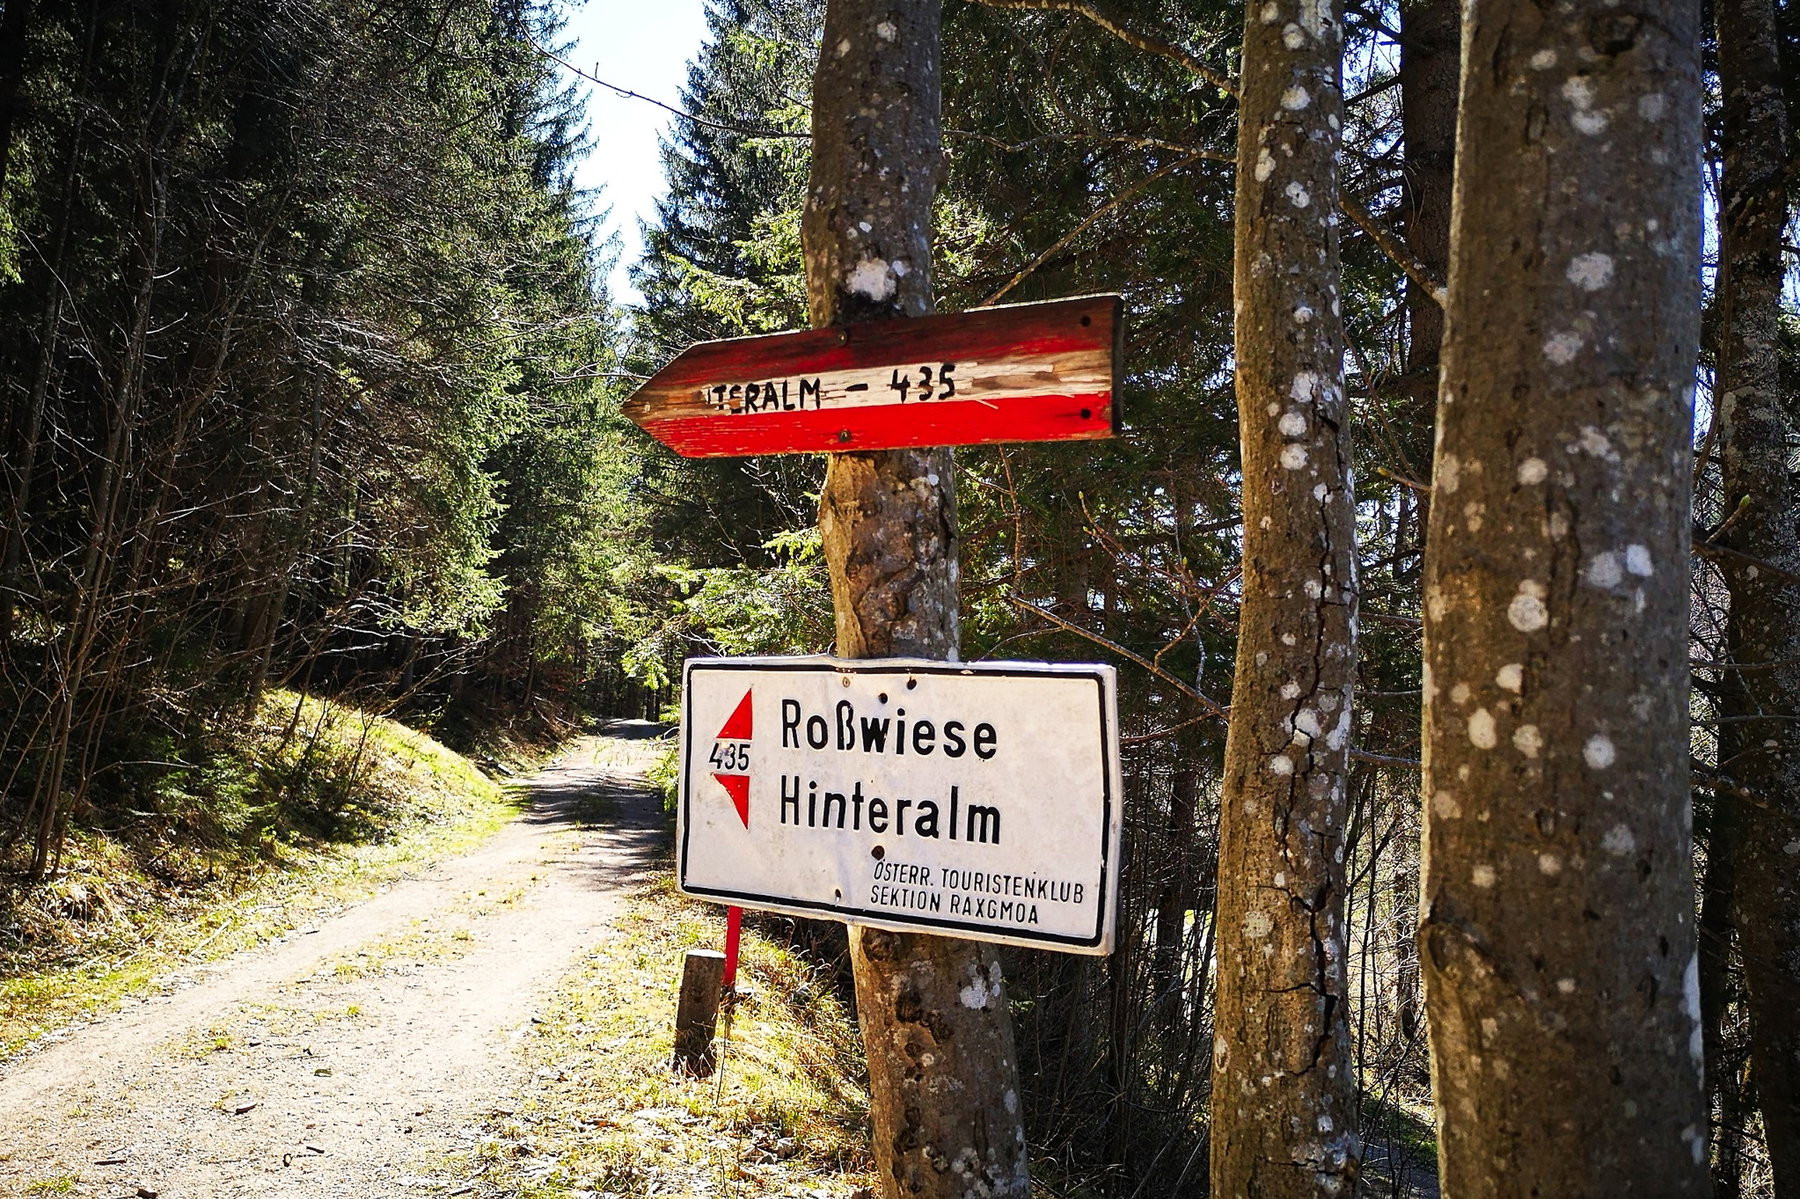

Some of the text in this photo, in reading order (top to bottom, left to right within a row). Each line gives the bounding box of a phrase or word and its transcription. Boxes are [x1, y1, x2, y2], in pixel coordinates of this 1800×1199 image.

[887, 364, 956, 403] 435
[781, 698, 998, 760] Roßwiese
[708, 742, 750, 771] 435
[780, 774, 1001, 845] Hinteralm
[870, 885, 1039, 924] SEKTION RAXGMOA
[941, 868, 1085, 904] TOURISTENKLUB
